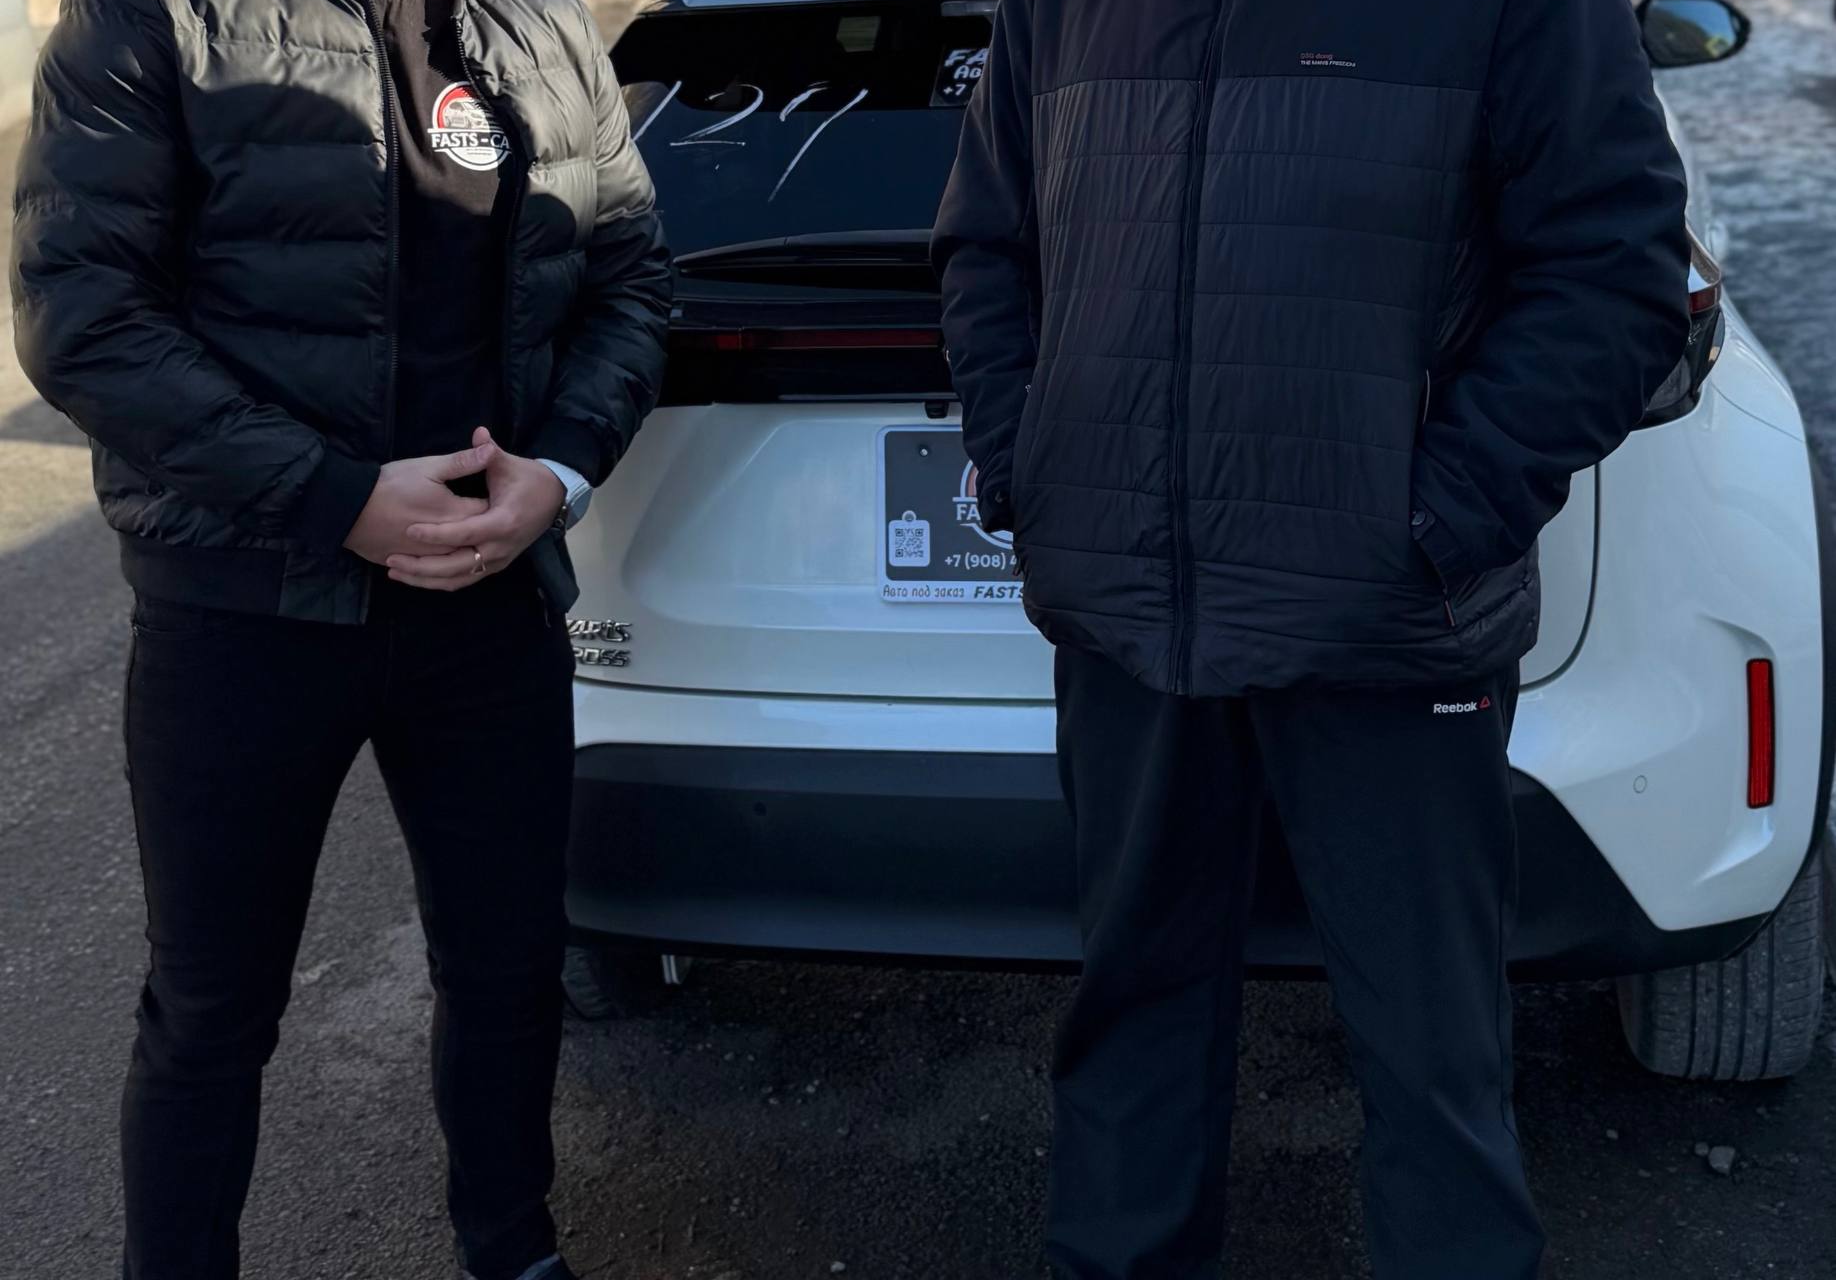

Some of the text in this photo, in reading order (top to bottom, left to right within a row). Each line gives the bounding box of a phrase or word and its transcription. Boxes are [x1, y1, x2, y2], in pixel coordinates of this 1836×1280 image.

[943, 84, 967, 96] +7
[944, 554, 961, 567] +7
[964, 551, 1006, 570] (908)
[883, 584, 908, 597] Авто
[934, 586, 965, 597] заказ
[1433, 701, 1477, 713] Reebok
